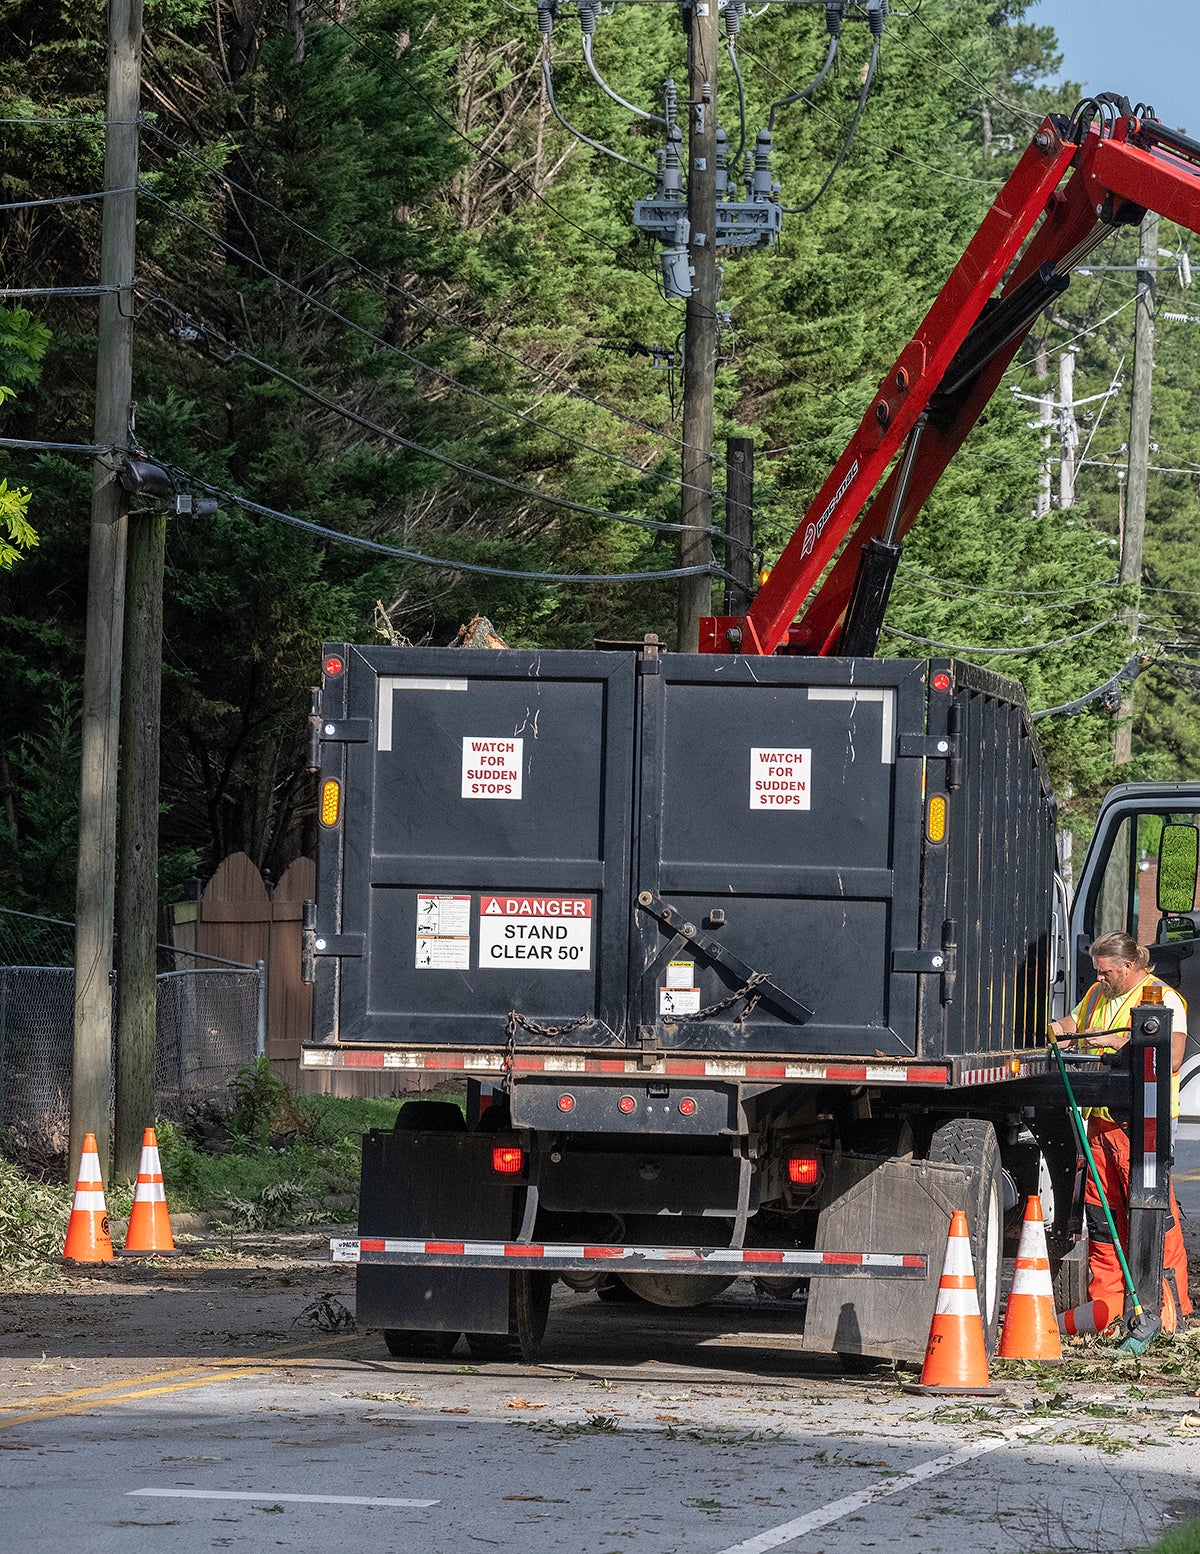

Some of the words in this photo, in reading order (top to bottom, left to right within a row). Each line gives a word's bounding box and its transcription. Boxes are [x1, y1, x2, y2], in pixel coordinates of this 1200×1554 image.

[471, 742, 514, 753] WATCH
[480, 756, 505, 766] FOR
[759, 753, 802, 763] WATCH
[466, 769, 517, 780] SUDDEN
[768, 767, 793, 777] FOR
[471, 783, 513, 794] STOPS
[755, 780, 806, 791] SUDDEN
[760, 794, 801, 805] STOPS
[505, 899, 586, 916] DANGER
[504, 924, 568, 940] STAND
[490, 944, 553, 960] CLEAR
[558, 946, 584, 960] 50'
